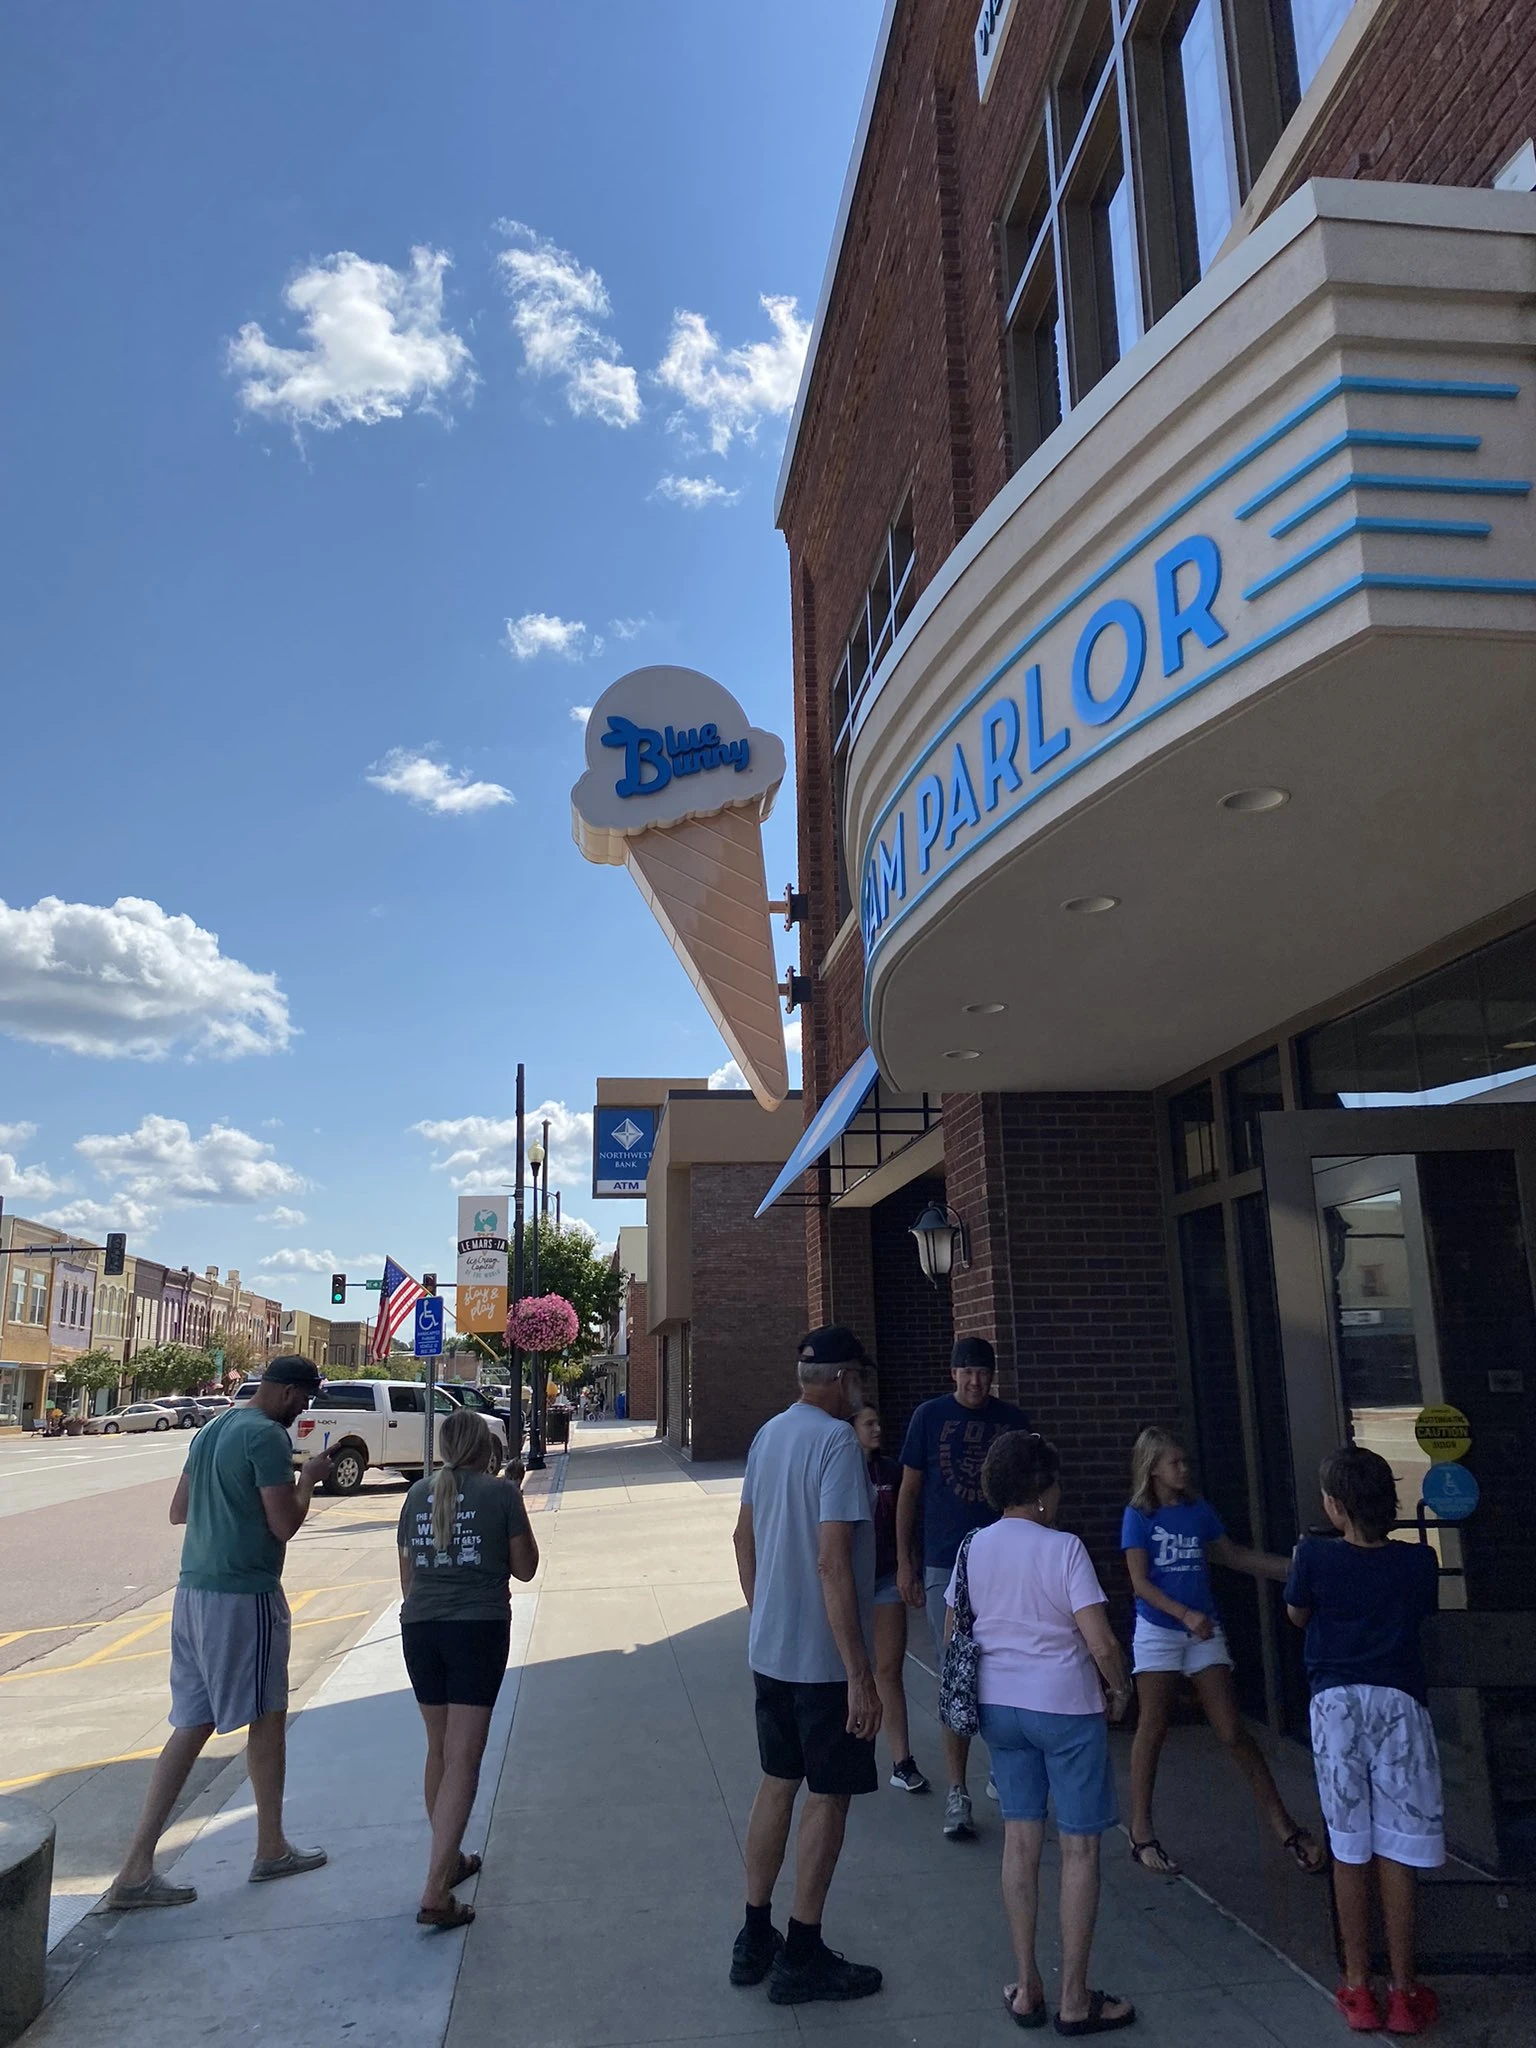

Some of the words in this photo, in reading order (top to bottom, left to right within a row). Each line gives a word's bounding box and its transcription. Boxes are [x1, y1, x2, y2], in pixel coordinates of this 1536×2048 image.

[916, 534, 1229, 875] PARLOR
[599, 1151, 652, 1160] NORTHWEST
[613, 1182, 639, 1190] ATM
[461, 1241, 471, 1252] LE
[471, 1239, 493, 1249] MARS
[477, 1256, 500, 1264] Cream
[471, 1261, 496, 1272] Capital
[464, 1286, 489, 1306] stay
[470, 1299, 495, 1321] play
[1416, 1426, 1469, 1438] CAUTION
[416, 1512, 428, 1522] THE
[456, 1510, 476, 1520] PLAY
[411, 1537, 424, 1546] THE
[461, 1535, 482, 1545] GETS
